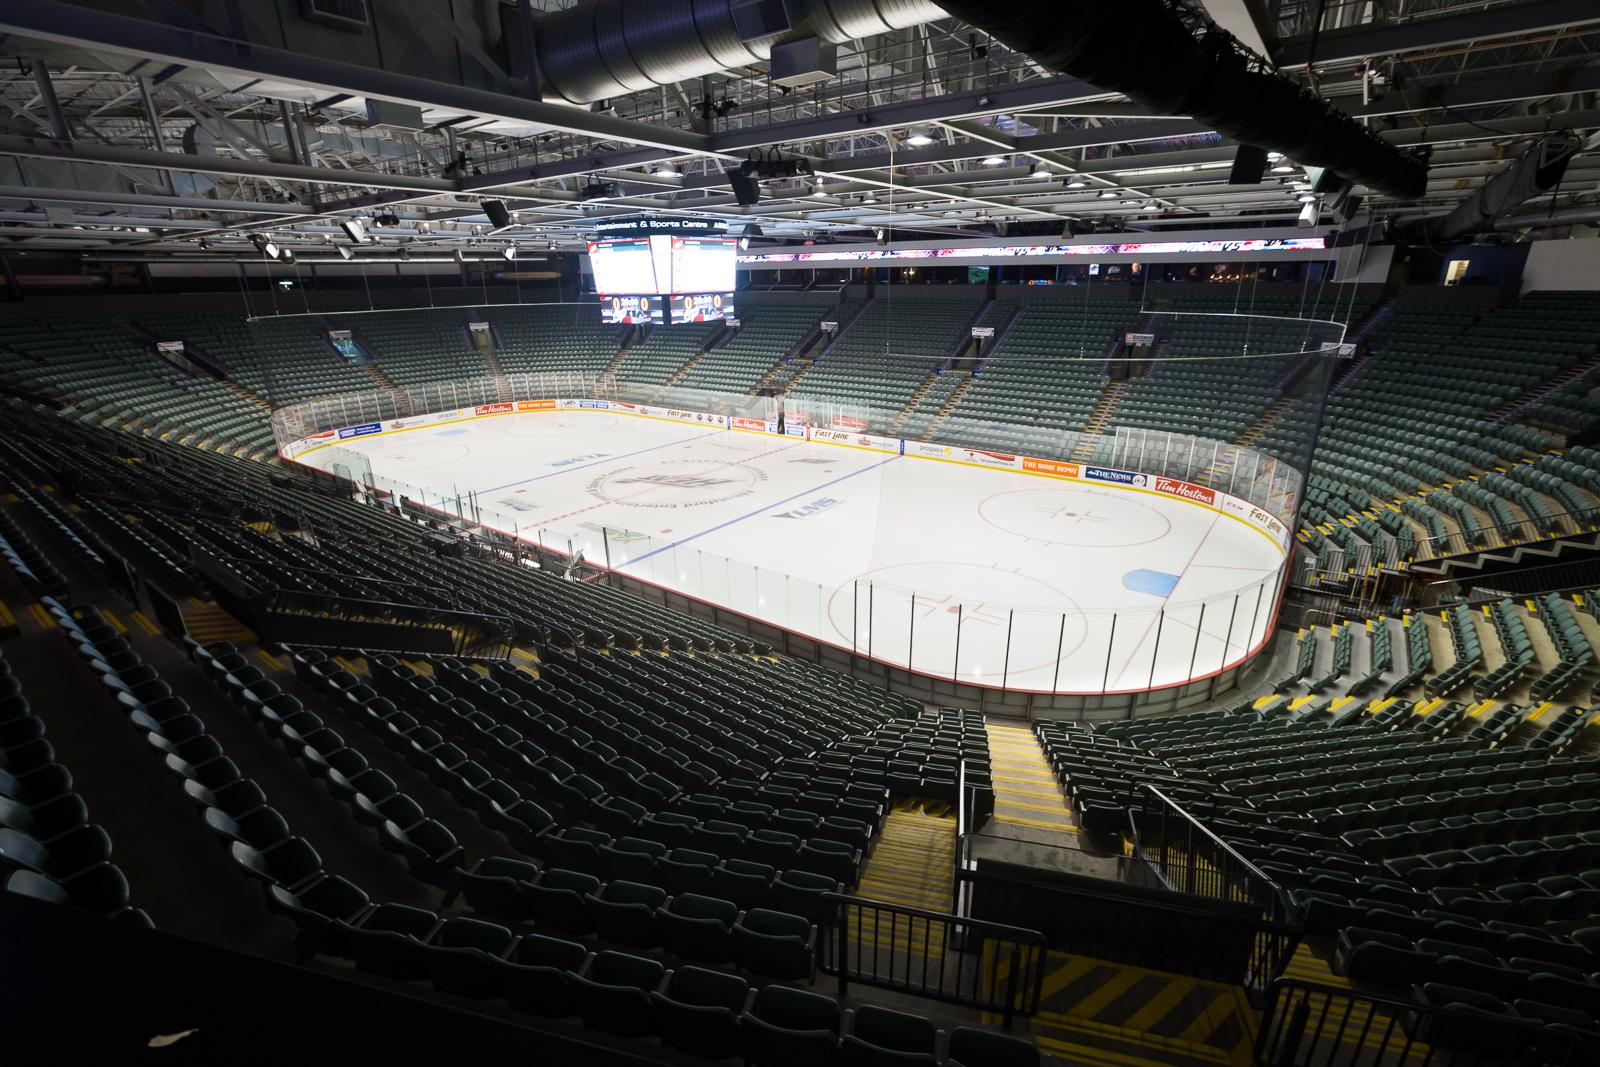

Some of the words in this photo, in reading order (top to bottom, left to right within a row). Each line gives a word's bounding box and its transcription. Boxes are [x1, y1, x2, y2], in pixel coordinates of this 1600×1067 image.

[640, 220, 647, 228] &
[650, 220, 680, 229] Sports
[682, 221, 708, 229] Centre
[488, 405, 512, 414] Hortons
[743, 418, 764, 431] Hortons
[919, 444, 944, 454] prospera
[1024, 461, 1036, 469] THE
[1037, 463, 1056, 472] HOME
[1056, 465, 1078, 475] DEPOT
[1156, 479, 1175, 493] Tim
[1176, 482, 1213, 504] Hortons
